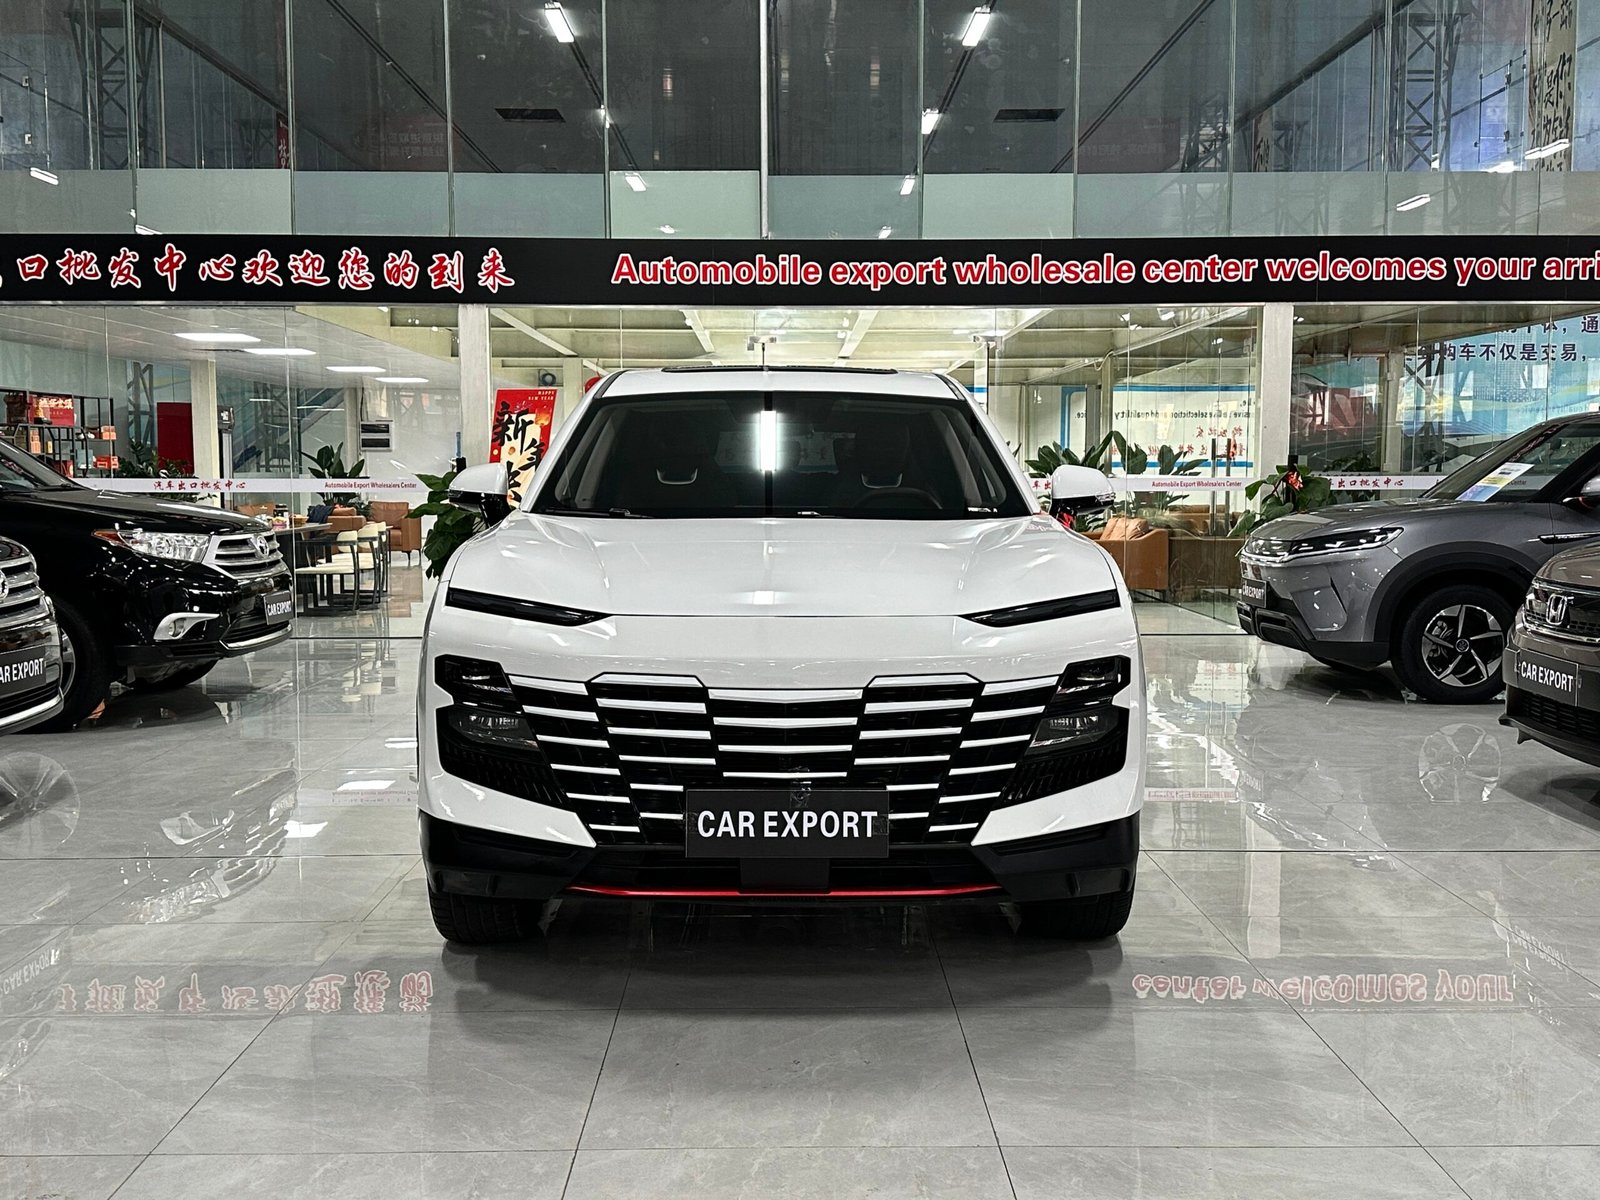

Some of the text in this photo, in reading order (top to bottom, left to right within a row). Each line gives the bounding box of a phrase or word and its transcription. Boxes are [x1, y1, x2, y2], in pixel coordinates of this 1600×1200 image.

[0, 243, 516, 294] 口批发中心欢迎您的到来
[612, 252, 823, 286] Automobile
[829, 256, 946, 290] export
[953, 252, 1136, 286] wholesale
[1142, 253, 1258, 284] center
[1264, 250, 1446, 283] welcomes
[1456, 255, 1536, 287] your
[153, 481, 247, 491] 汽车出口批发中心
[353, 481, 370, 489] Export
[1152, 480, 1179, 488] Automobile
[1180, 480, 1196, 489] Export
[277, 600, 292, 615] EXPORT
[12, 657, 44, 681] EXPORT
[1520, 660, 1574, 694] CAR EXPORT
[697, 810, 878, 838] CAR EXPORT
